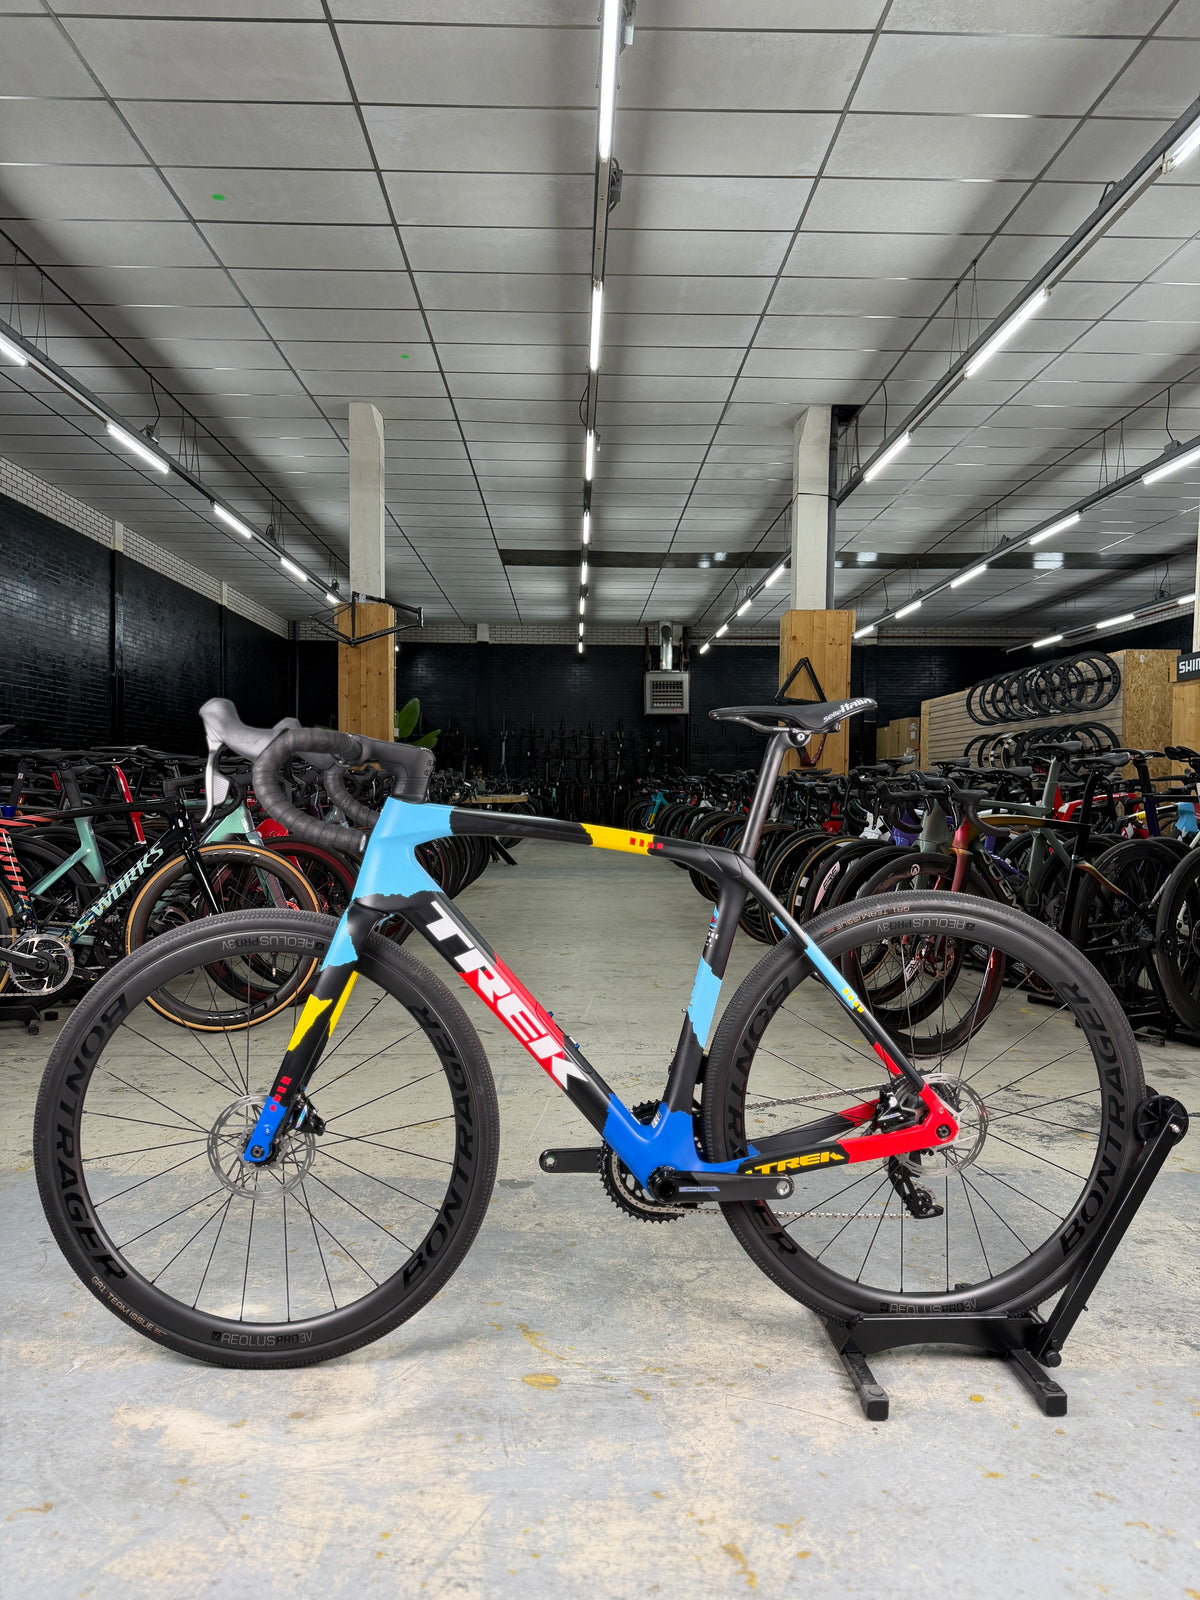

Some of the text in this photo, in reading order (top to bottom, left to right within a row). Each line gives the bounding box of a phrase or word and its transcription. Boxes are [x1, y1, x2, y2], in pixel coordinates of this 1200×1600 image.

[74, 841, 164, 937] S-WORKS
[426, 900, 589, 1091] TREK
[57, 992, 128, 1280] BONTRAGER
[403, 1003, 474, 1290] BONTRAGER
[754, 1151, 845, 1174] TREK
[1056, 980, 1126, 1257] BONTRAGER
[107, 1291, 130, 1315] TEAM
[129, 1311, 155, 1331] ISSUE
